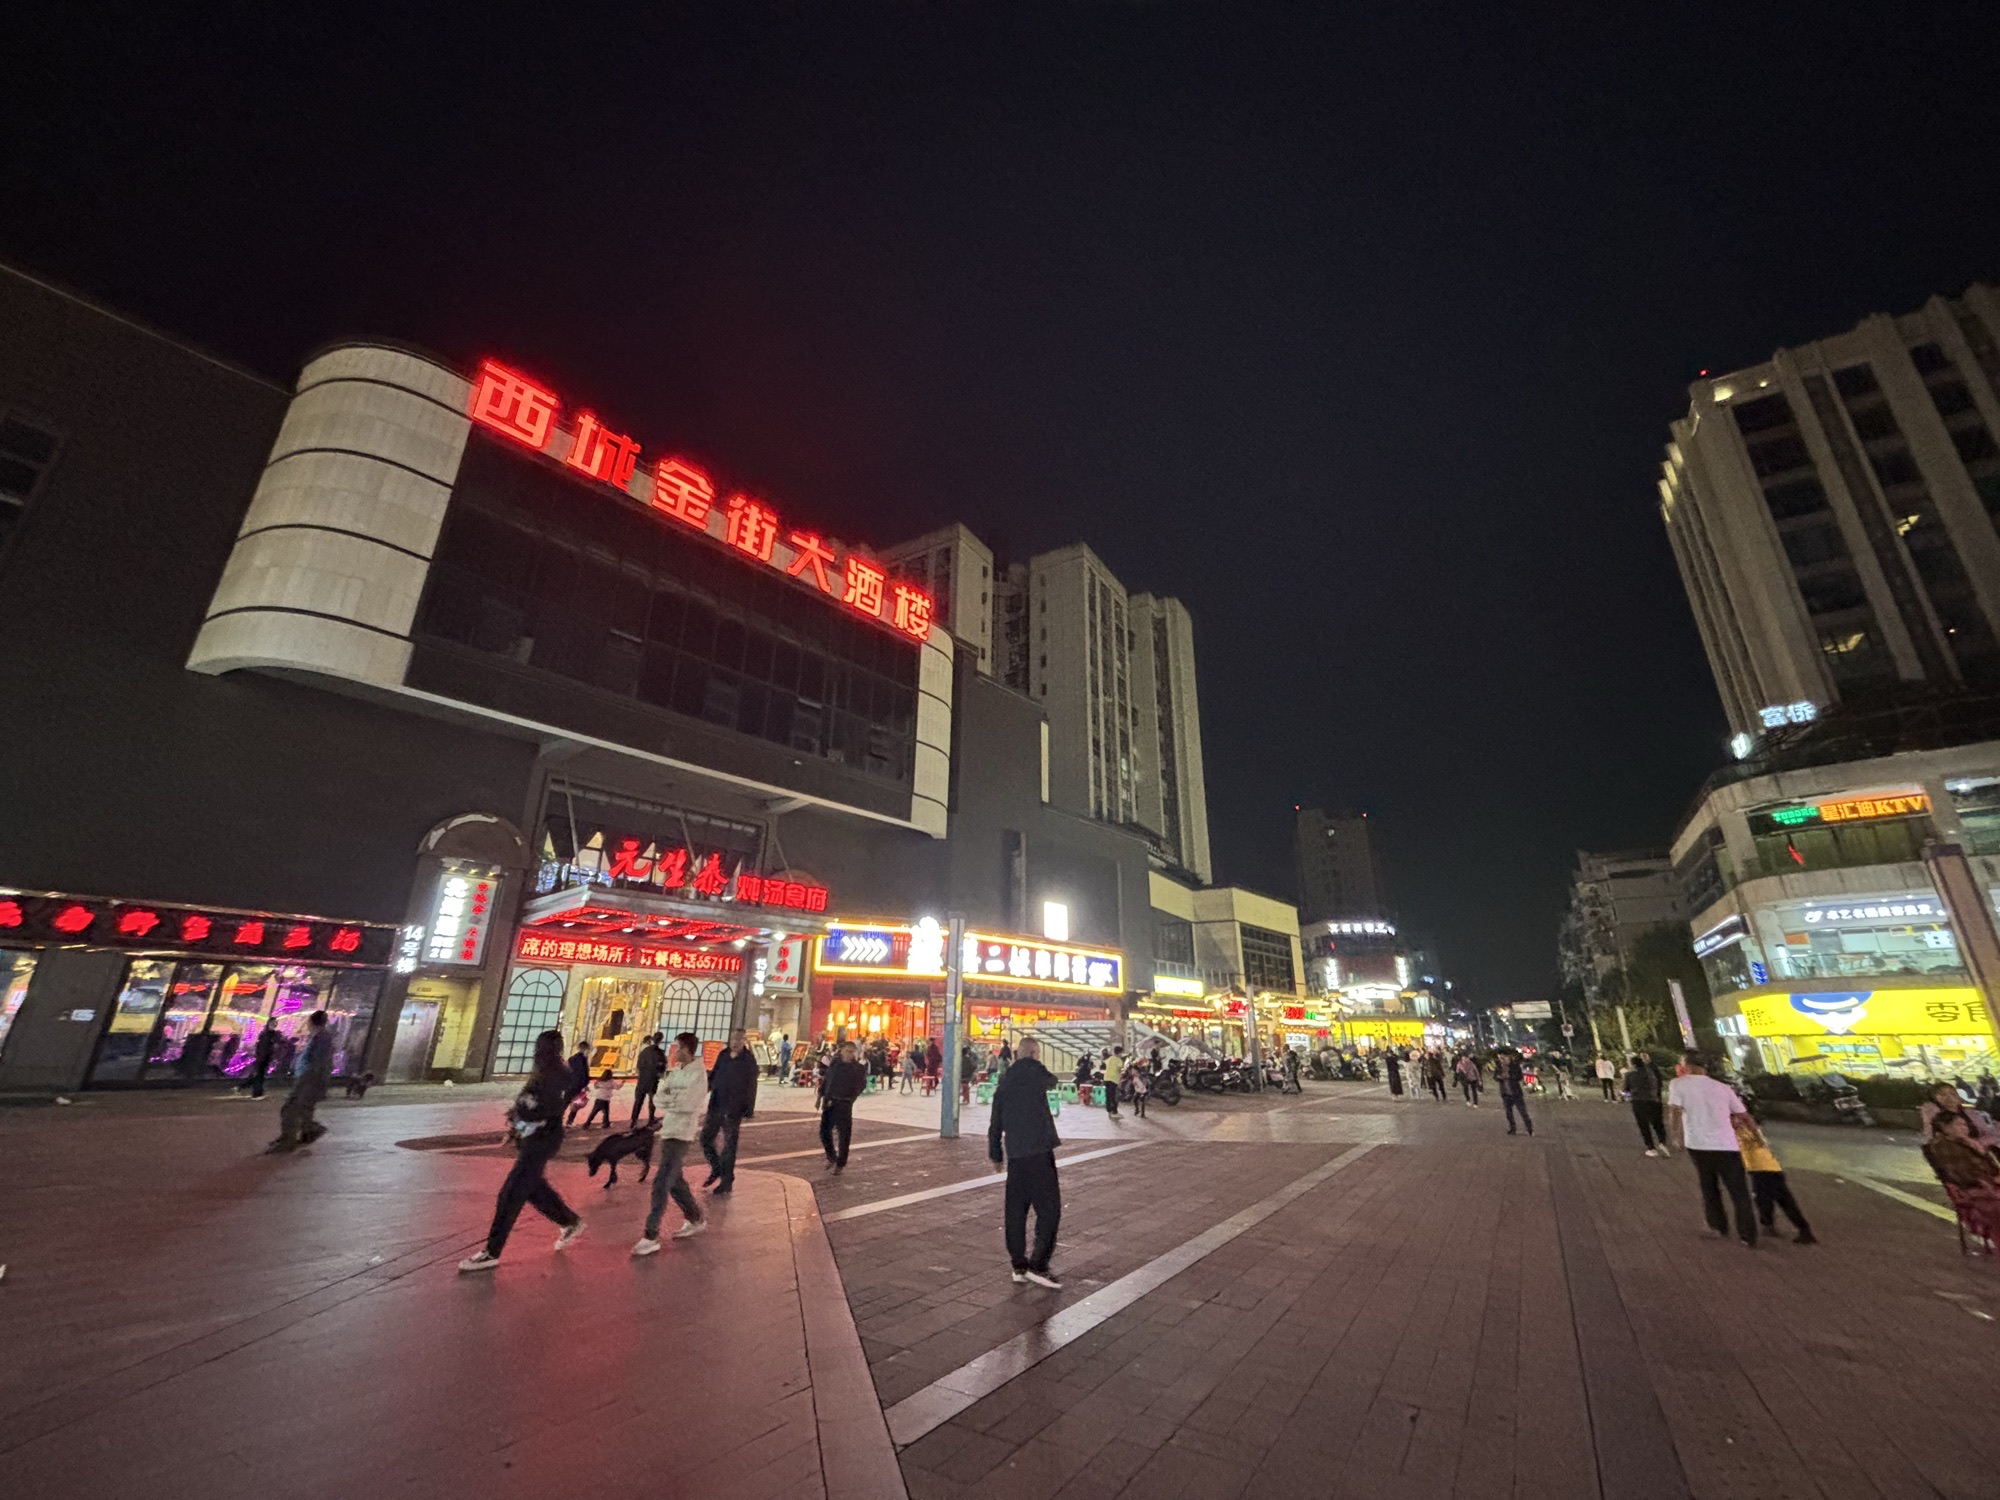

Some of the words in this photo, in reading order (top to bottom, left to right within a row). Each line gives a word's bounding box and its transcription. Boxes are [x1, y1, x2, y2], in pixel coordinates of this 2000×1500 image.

[473, 362, 931, 640] 西城金街大酒楼
[1820, 796, 1923, 821] 星汇迪KTV
[609, 839, 728, 894] 元生泰
[736, 875, 828, 911] 炖汤食府
[460, 882, 489, 960] 西城金大酒楼
